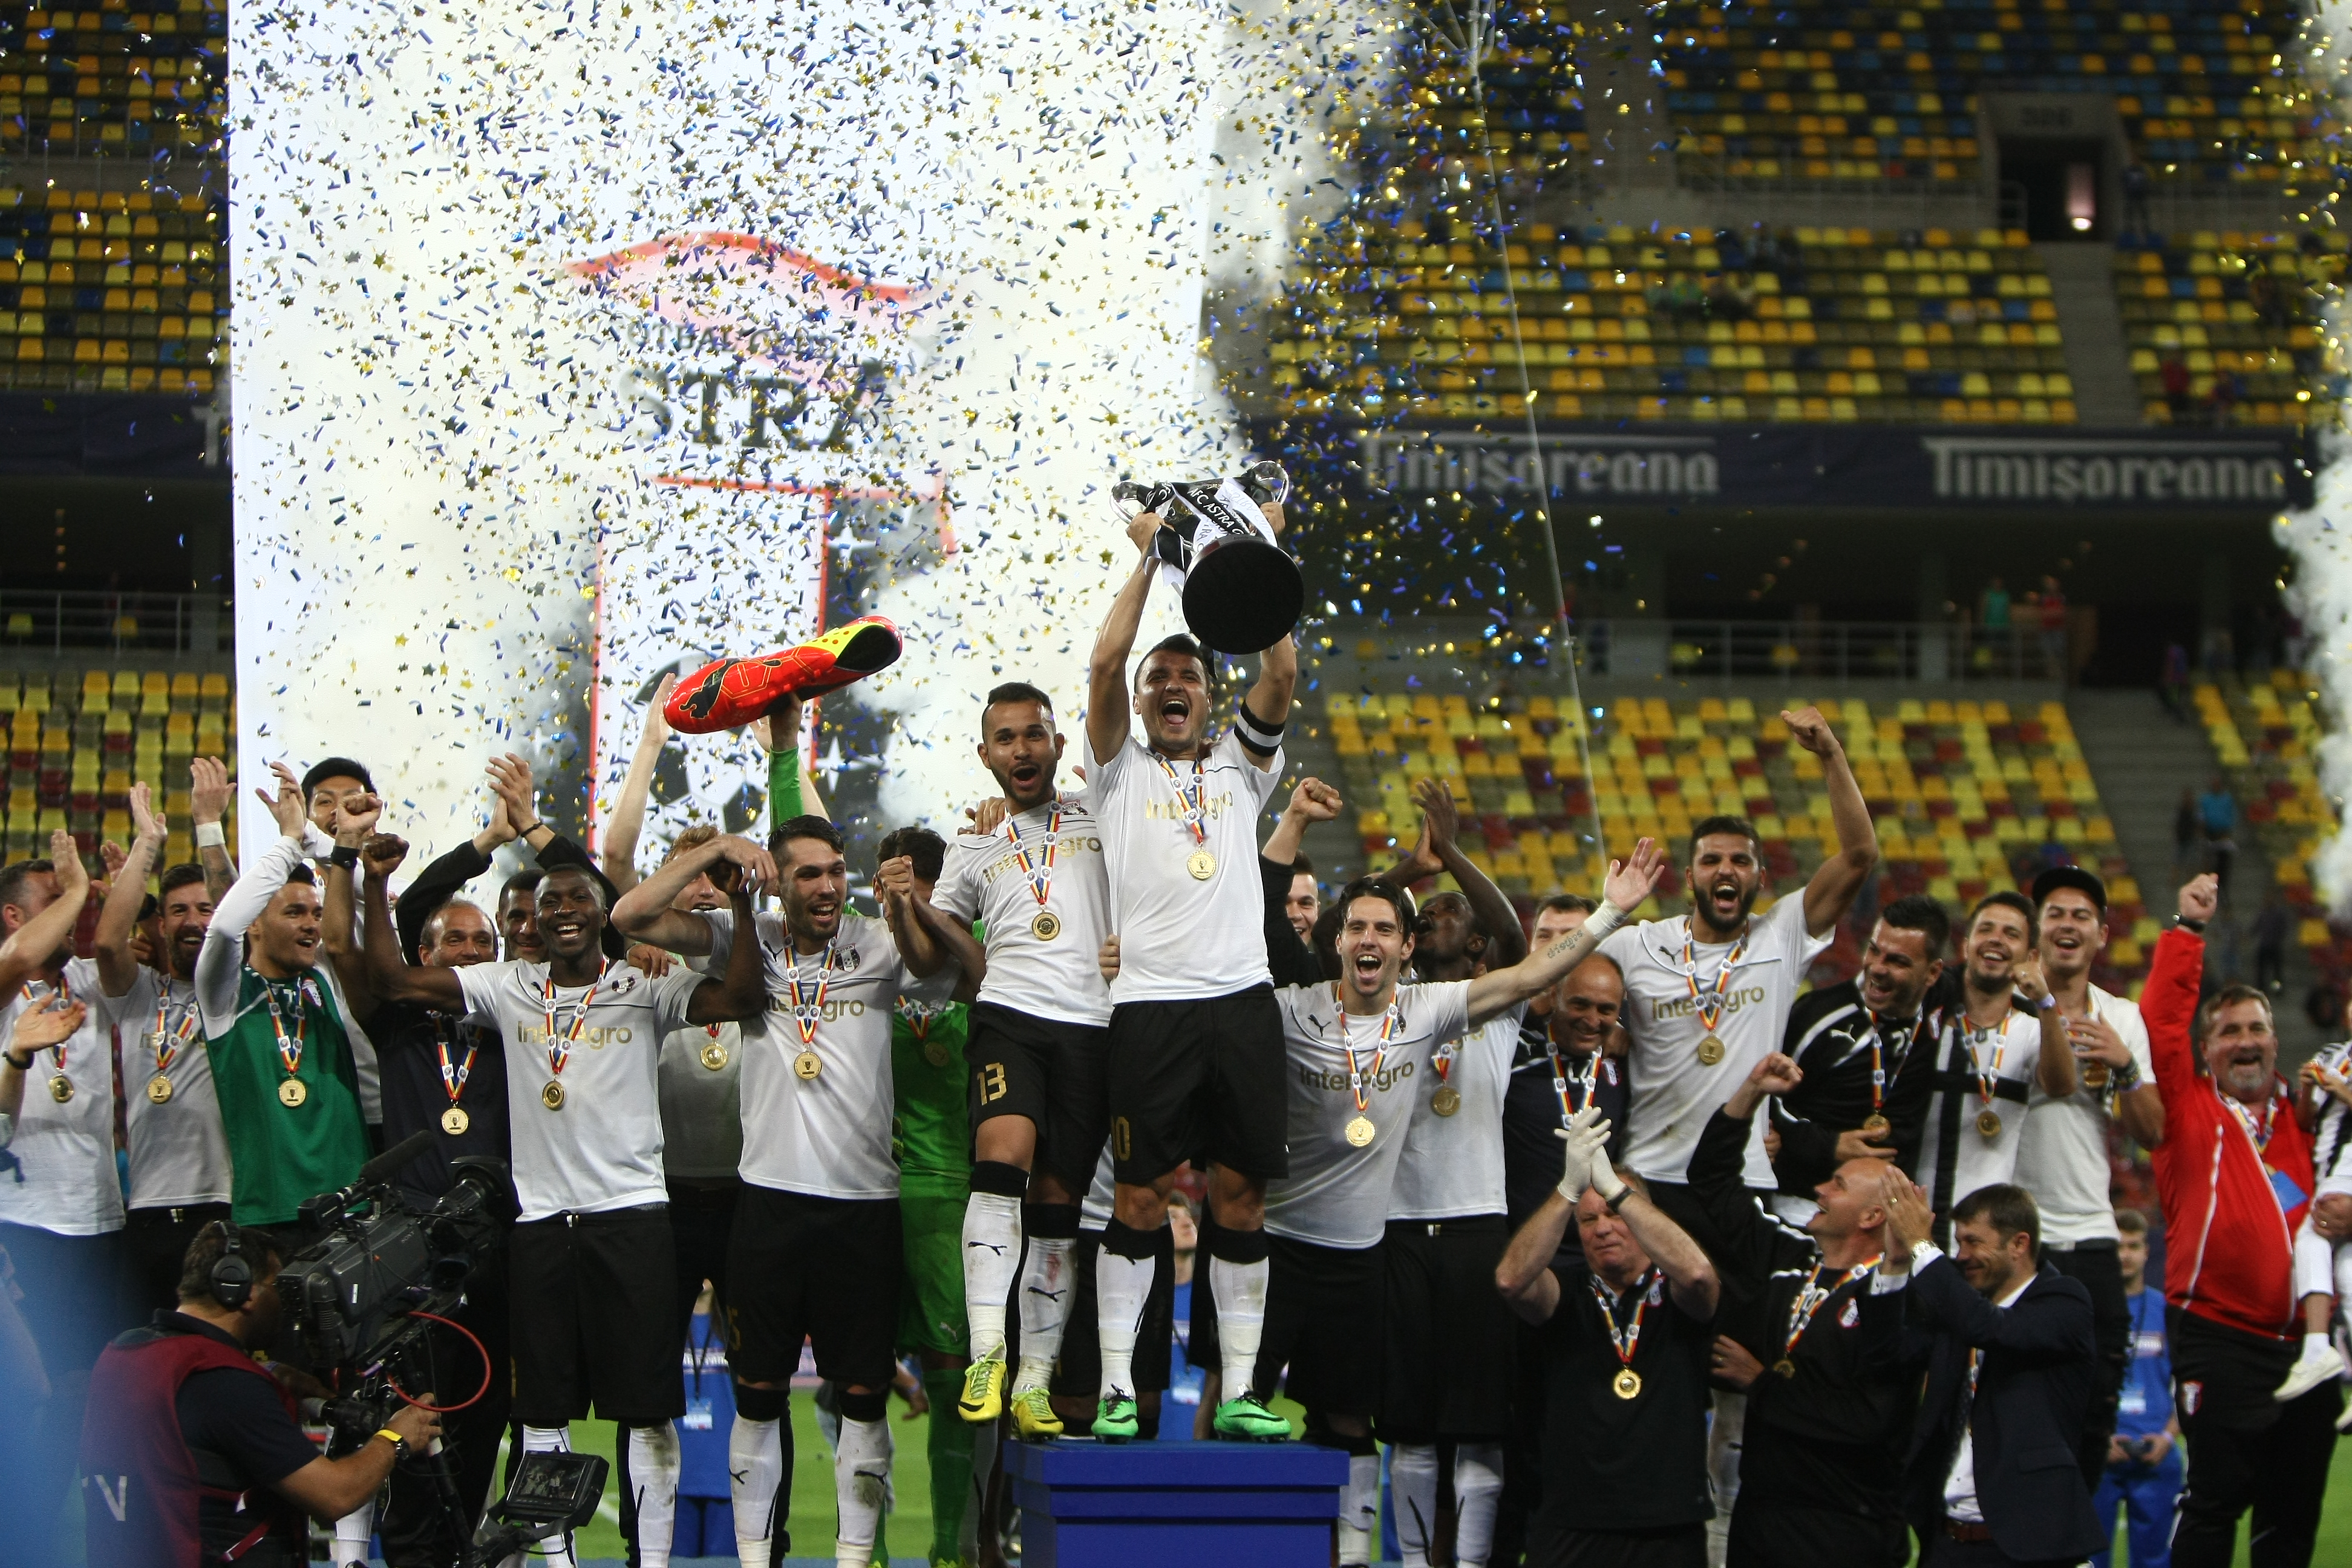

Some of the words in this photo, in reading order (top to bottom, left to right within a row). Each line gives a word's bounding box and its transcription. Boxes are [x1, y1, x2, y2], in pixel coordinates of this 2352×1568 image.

[1187, 488, 1210, 505] AFC
[1203, 503, 1235, 528] ASTRA
[1145, 790, 1234, 820] Integro
[1653, 986, 1765, 1021] Integro
[977, 1062, 1007, 1106] 13
[81, 1474, 127, 1521] V
